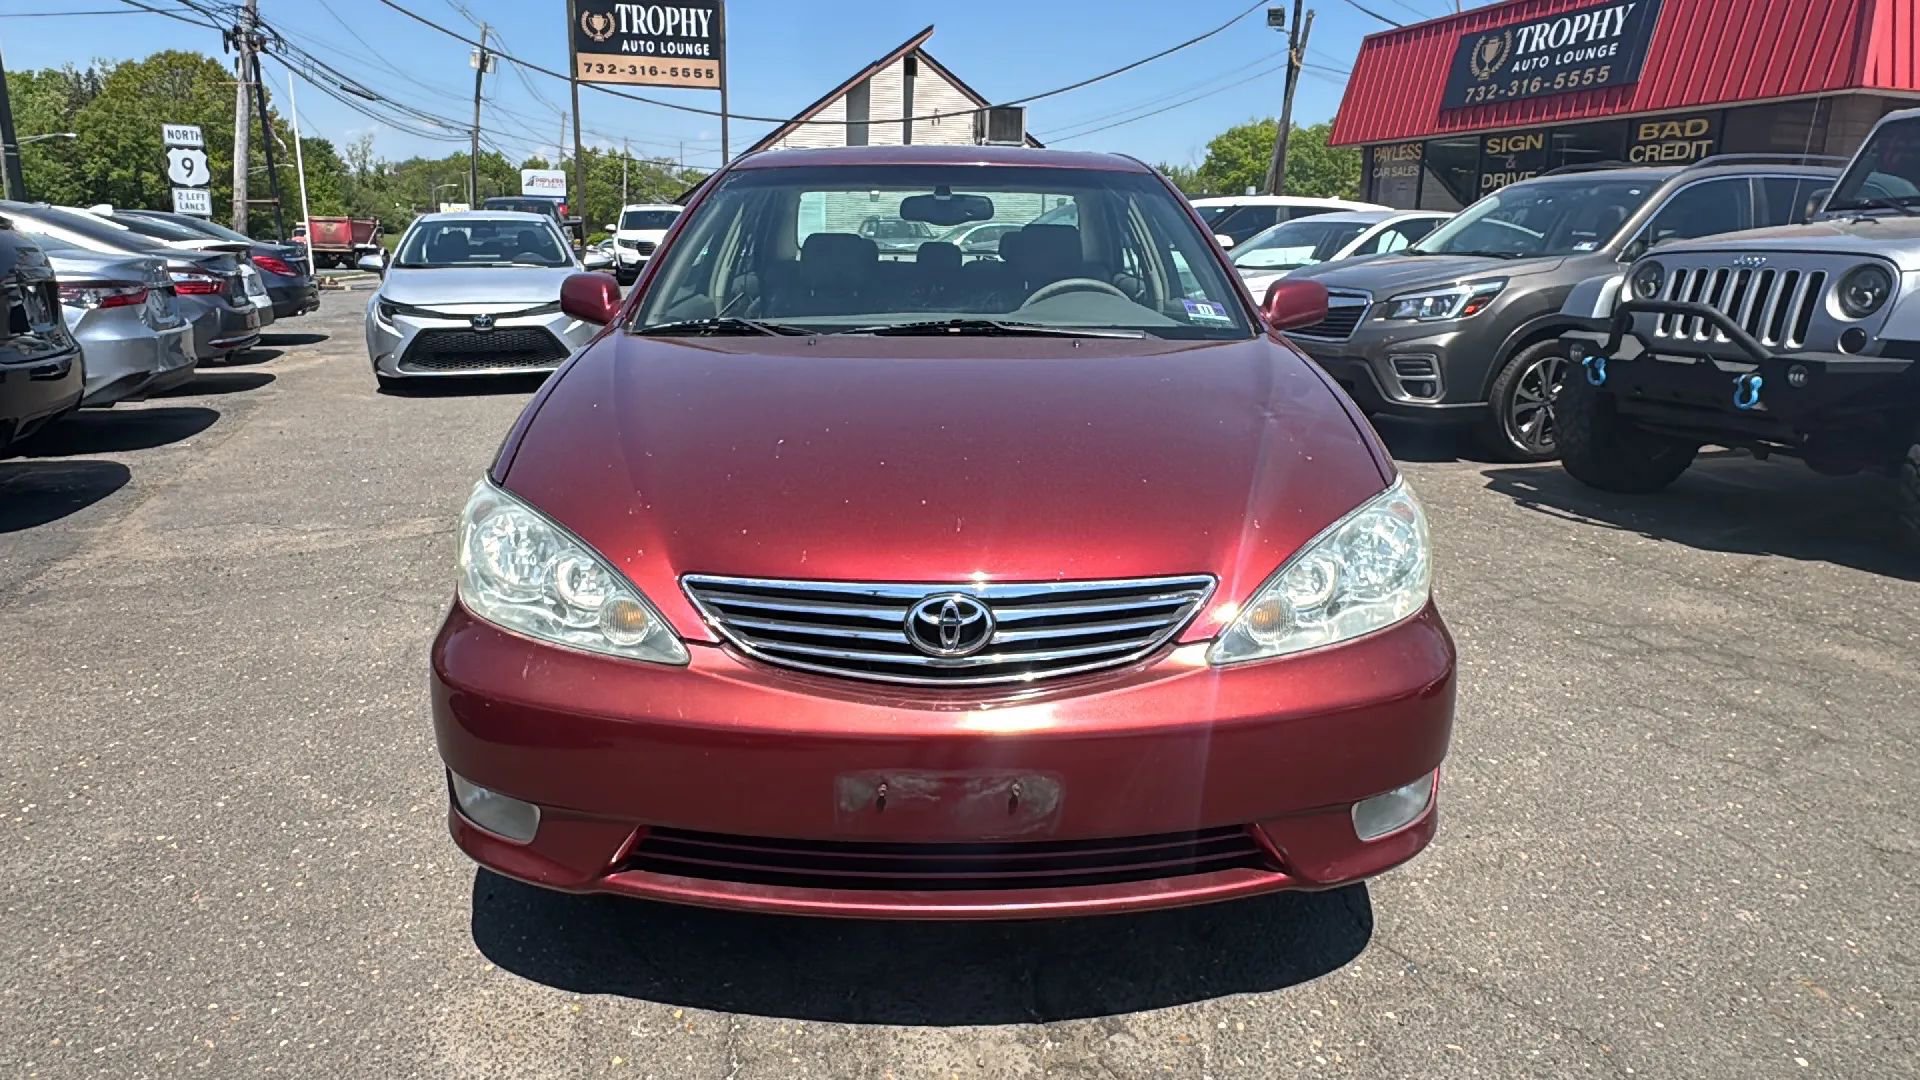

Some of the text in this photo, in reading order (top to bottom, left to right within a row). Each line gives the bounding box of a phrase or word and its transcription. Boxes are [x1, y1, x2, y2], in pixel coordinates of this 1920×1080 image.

[615, 3, 713, 38] TROPHY
[1515, 2, 1636, 55] TROPHY
[621, 39, 709, 56] AUTO LOUNGE
[1511, 42, 1619, 73] AUTO LOUNGE
[583, 62, 715, 79] 732-316-5555
[1465, 65, 1611, 104] 732-316-5555
[167, 129, 202, 141] NORTH
[1638, 118, 1709, 141] BAD
[1373, 142, 1423, 163] PAYLESS
[1485, 133, 1544, 154] SIGN
[1629, 140, 1714, 163] CREDIT
[182, 157, 194, 178] 9
[1372, 165, 1420, 178] CAR SALES
[1505, 157, 1517, 169] &
[178, 192, 205, 201] 2 LEFT
[179, 202, 206, 211] LANES
